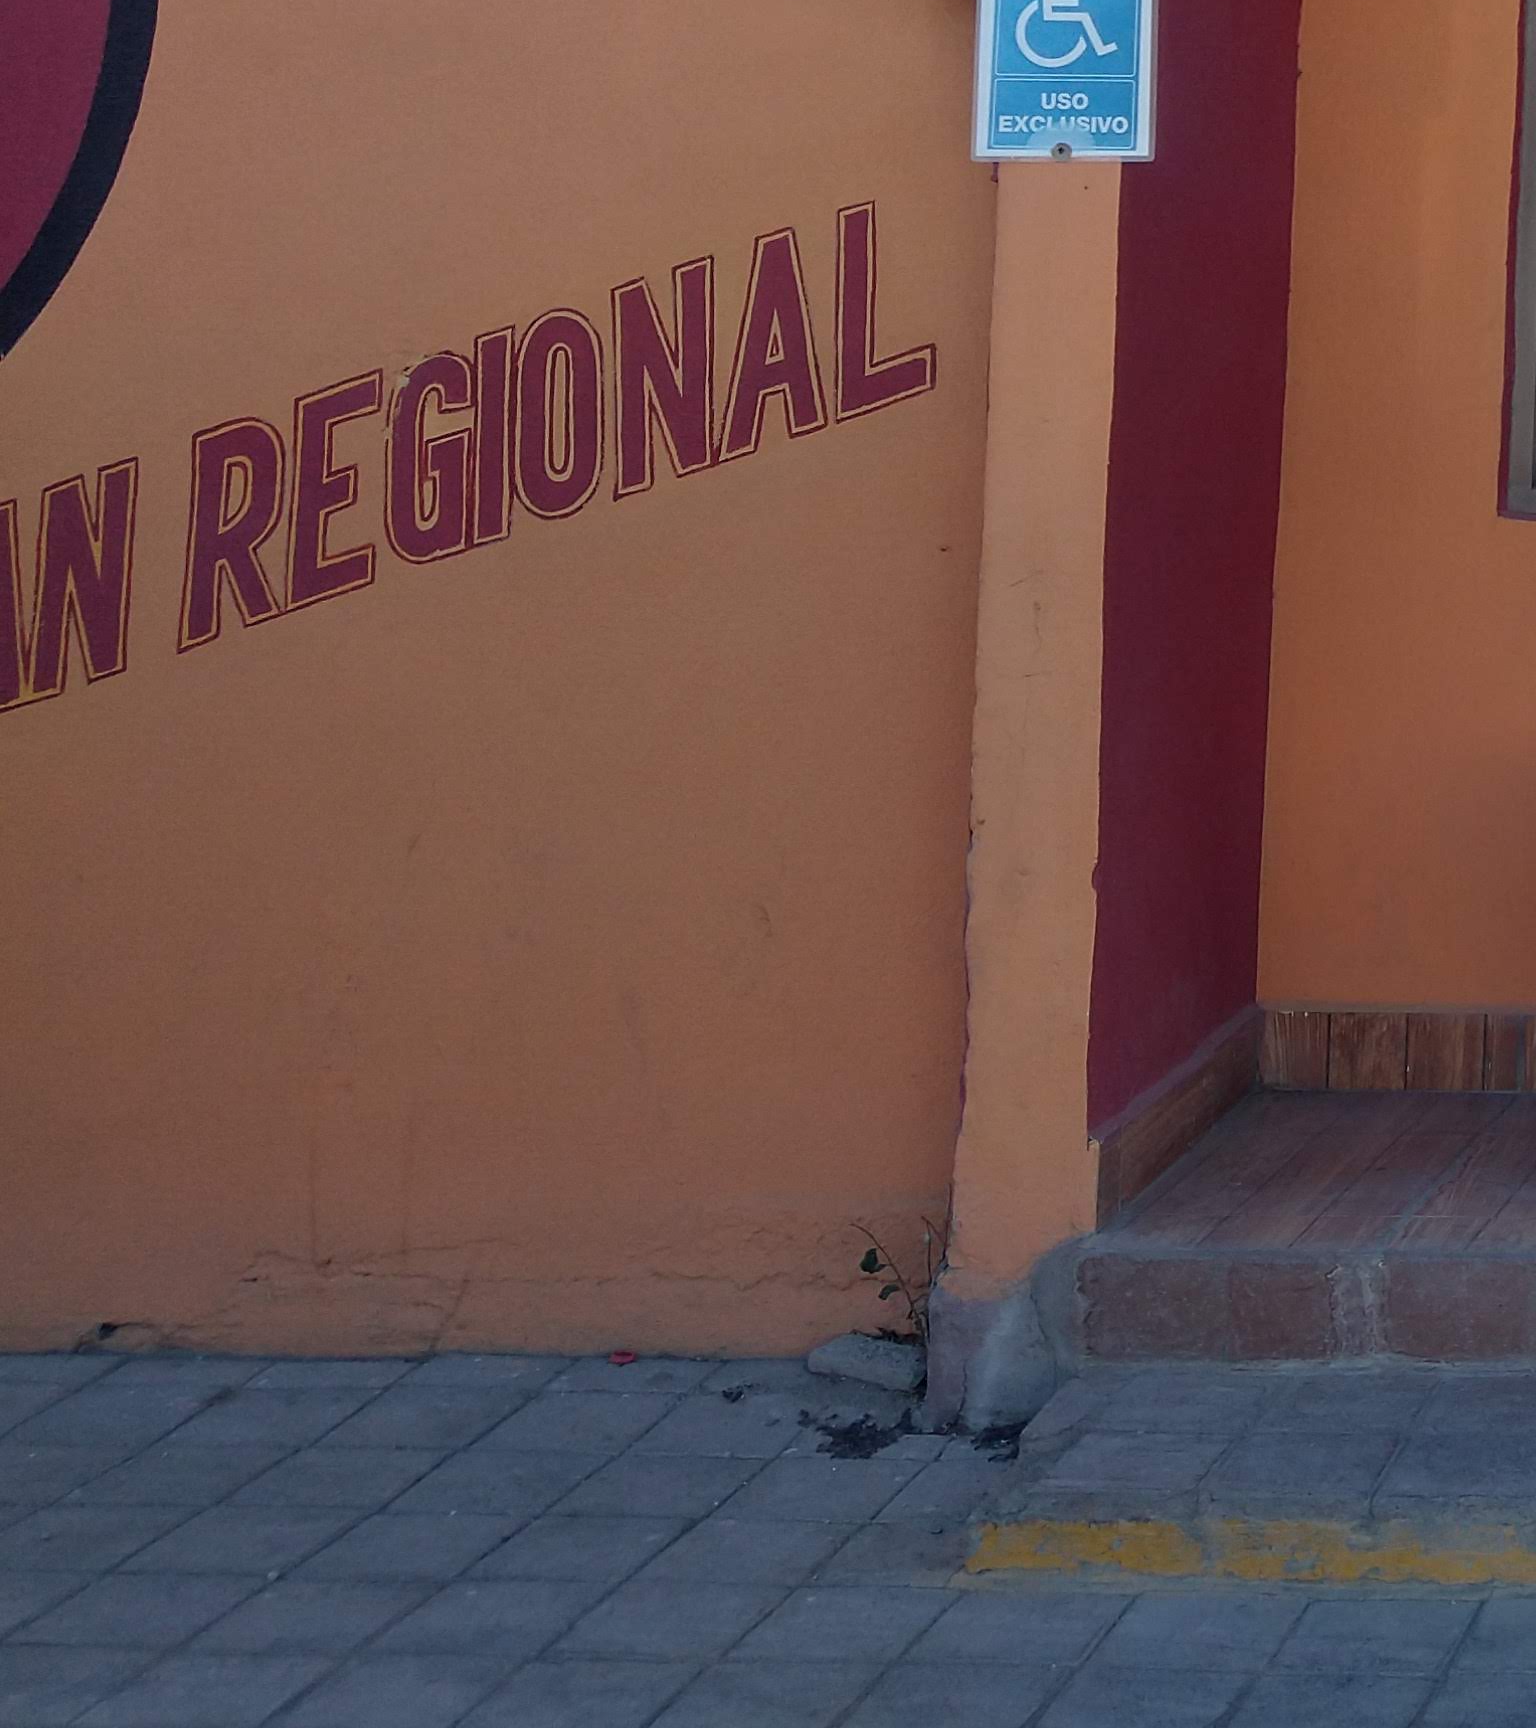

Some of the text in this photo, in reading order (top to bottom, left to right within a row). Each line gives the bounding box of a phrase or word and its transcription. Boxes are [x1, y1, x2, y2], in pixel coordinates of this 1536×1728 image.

[1040, 92, 1089, 110] USO
[998, 115, 1129, 134] EXCLUSIVO
[178, 201, 936, 654] REGIONAL
